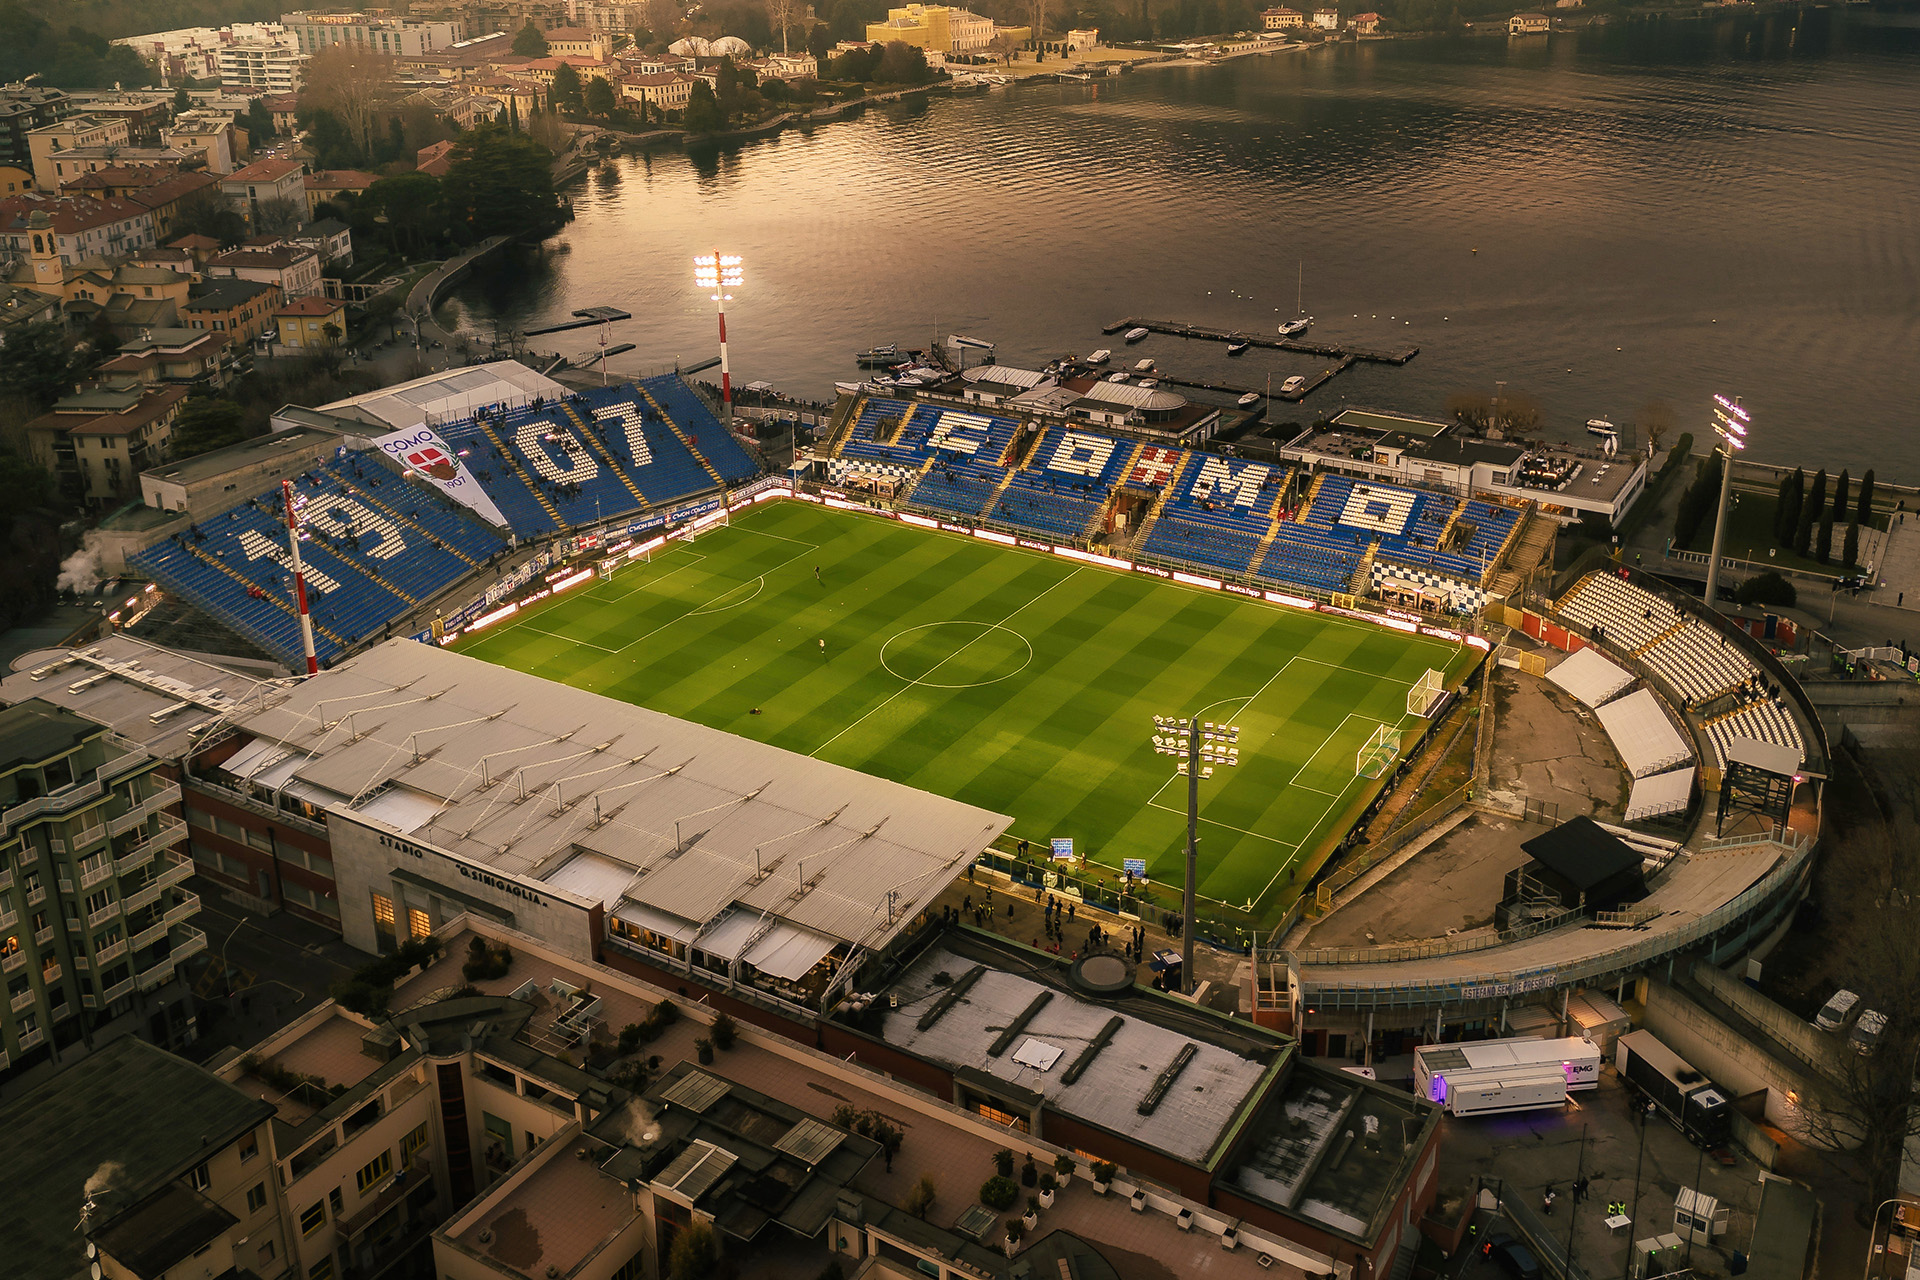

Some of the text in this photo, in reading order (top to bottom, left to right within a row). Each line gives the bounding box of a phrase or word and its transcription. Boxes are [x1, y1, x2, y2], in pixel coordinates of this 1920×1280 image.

[384, 431, 433, 453] COMO
[444, 476, 467, 489] 1907
[629, 501, 719, 532] C'MON BLUES C'MON COMO 1907
[440, 632, 458, 645] Uber
[379, 836, 423, 858] STADIO
[1468, 986, 1496, 999] STEFANO
[1573, 1064, 1593, 1074] EMG
